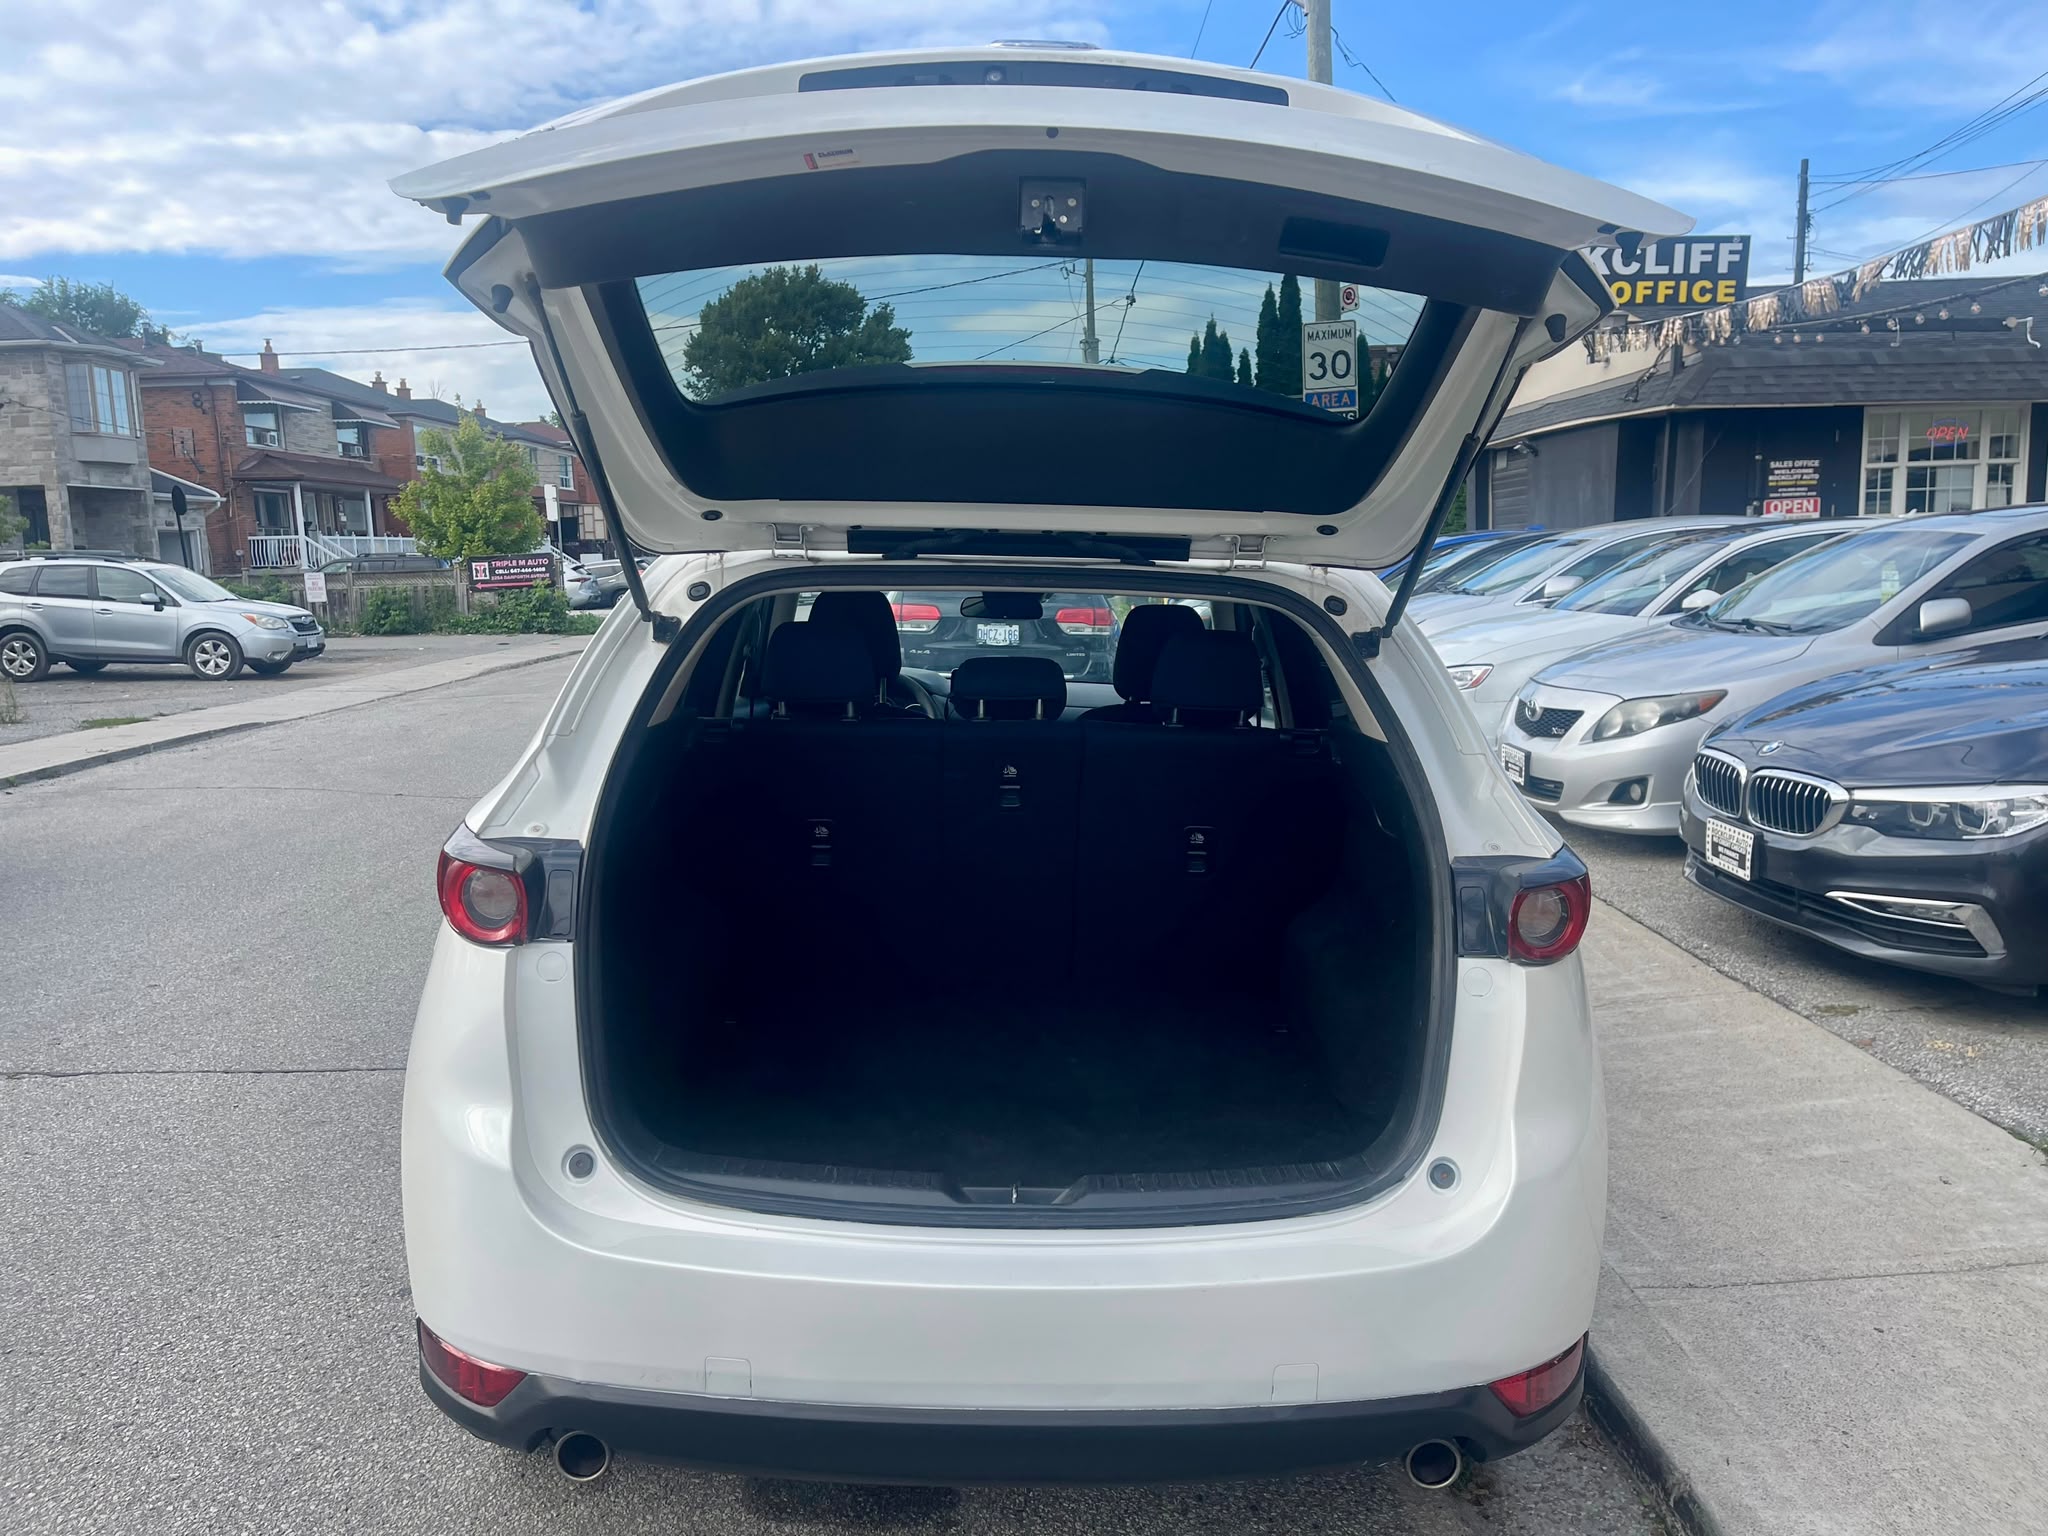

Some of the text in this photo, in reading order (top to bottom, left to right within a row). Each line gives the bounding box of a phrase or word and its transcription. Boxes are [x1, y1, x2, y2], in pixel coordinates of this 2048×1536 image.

[1610, 279, 1737, 304] OFFICE
[1307, 328, 1352, 341] MAXIMUM
[1309, 350, 1352, 380] 30
[1311, 391, 1350, 408] AREA
[1926, 426, 1969, 441] OPEN
[1770, 499, 1815, 514] OPEN
[491, 558, 549, 568] TRIPLE M AUTO
